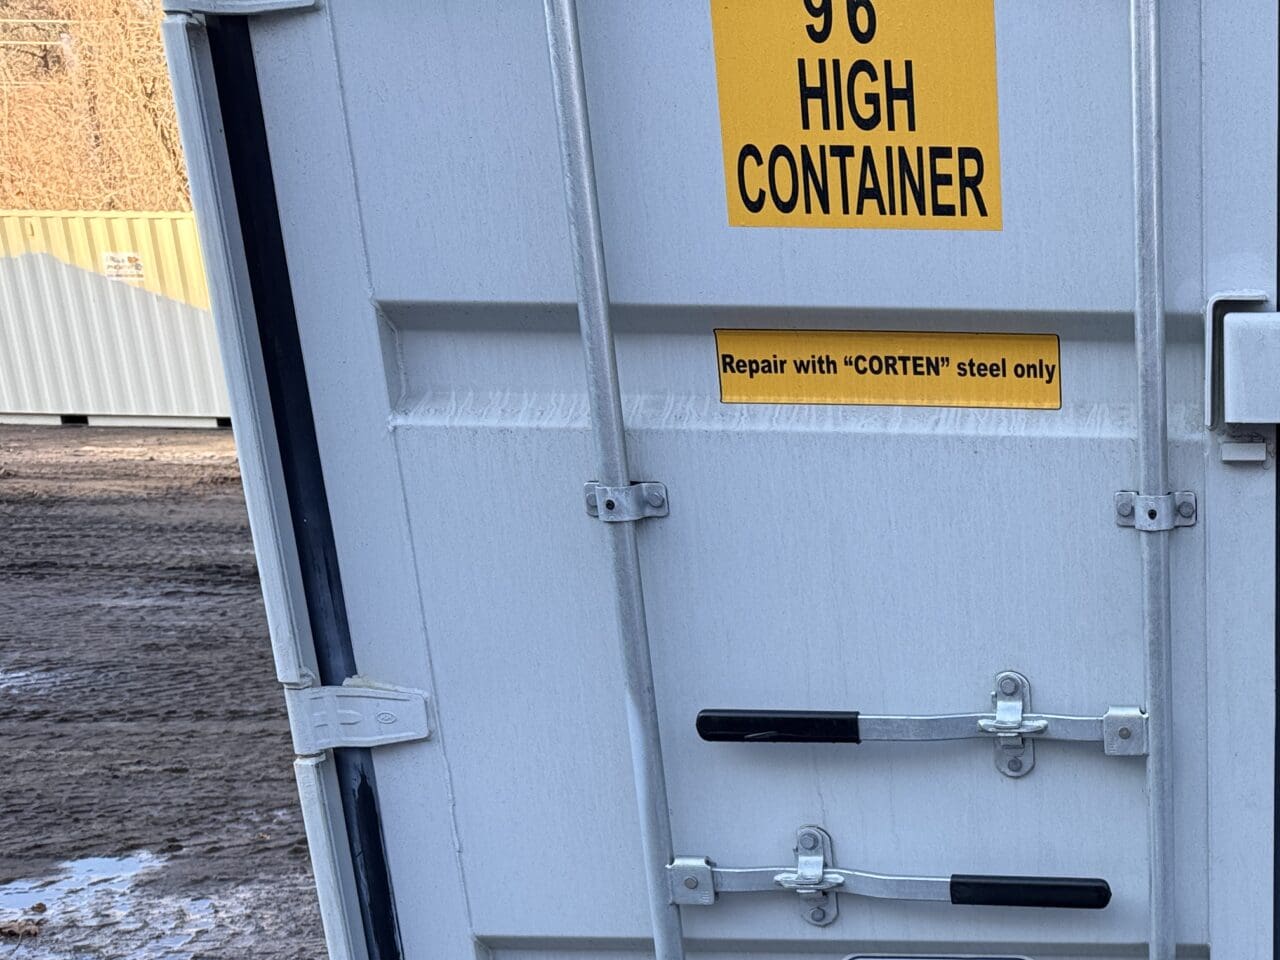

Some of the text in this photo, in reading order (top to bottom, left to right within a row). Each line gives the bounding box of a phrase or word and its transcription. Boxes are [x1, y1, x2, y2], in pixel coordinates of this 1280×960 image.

[798, 58, 915, 131] HIGH
[738, 144, 988, 217] CONTAINER
[721, 354, 788, 378] Repair
[794, 354, 838, 375] with
[957, 358, 1007, 378] steel
[1014, 359, 1056, 384] only
